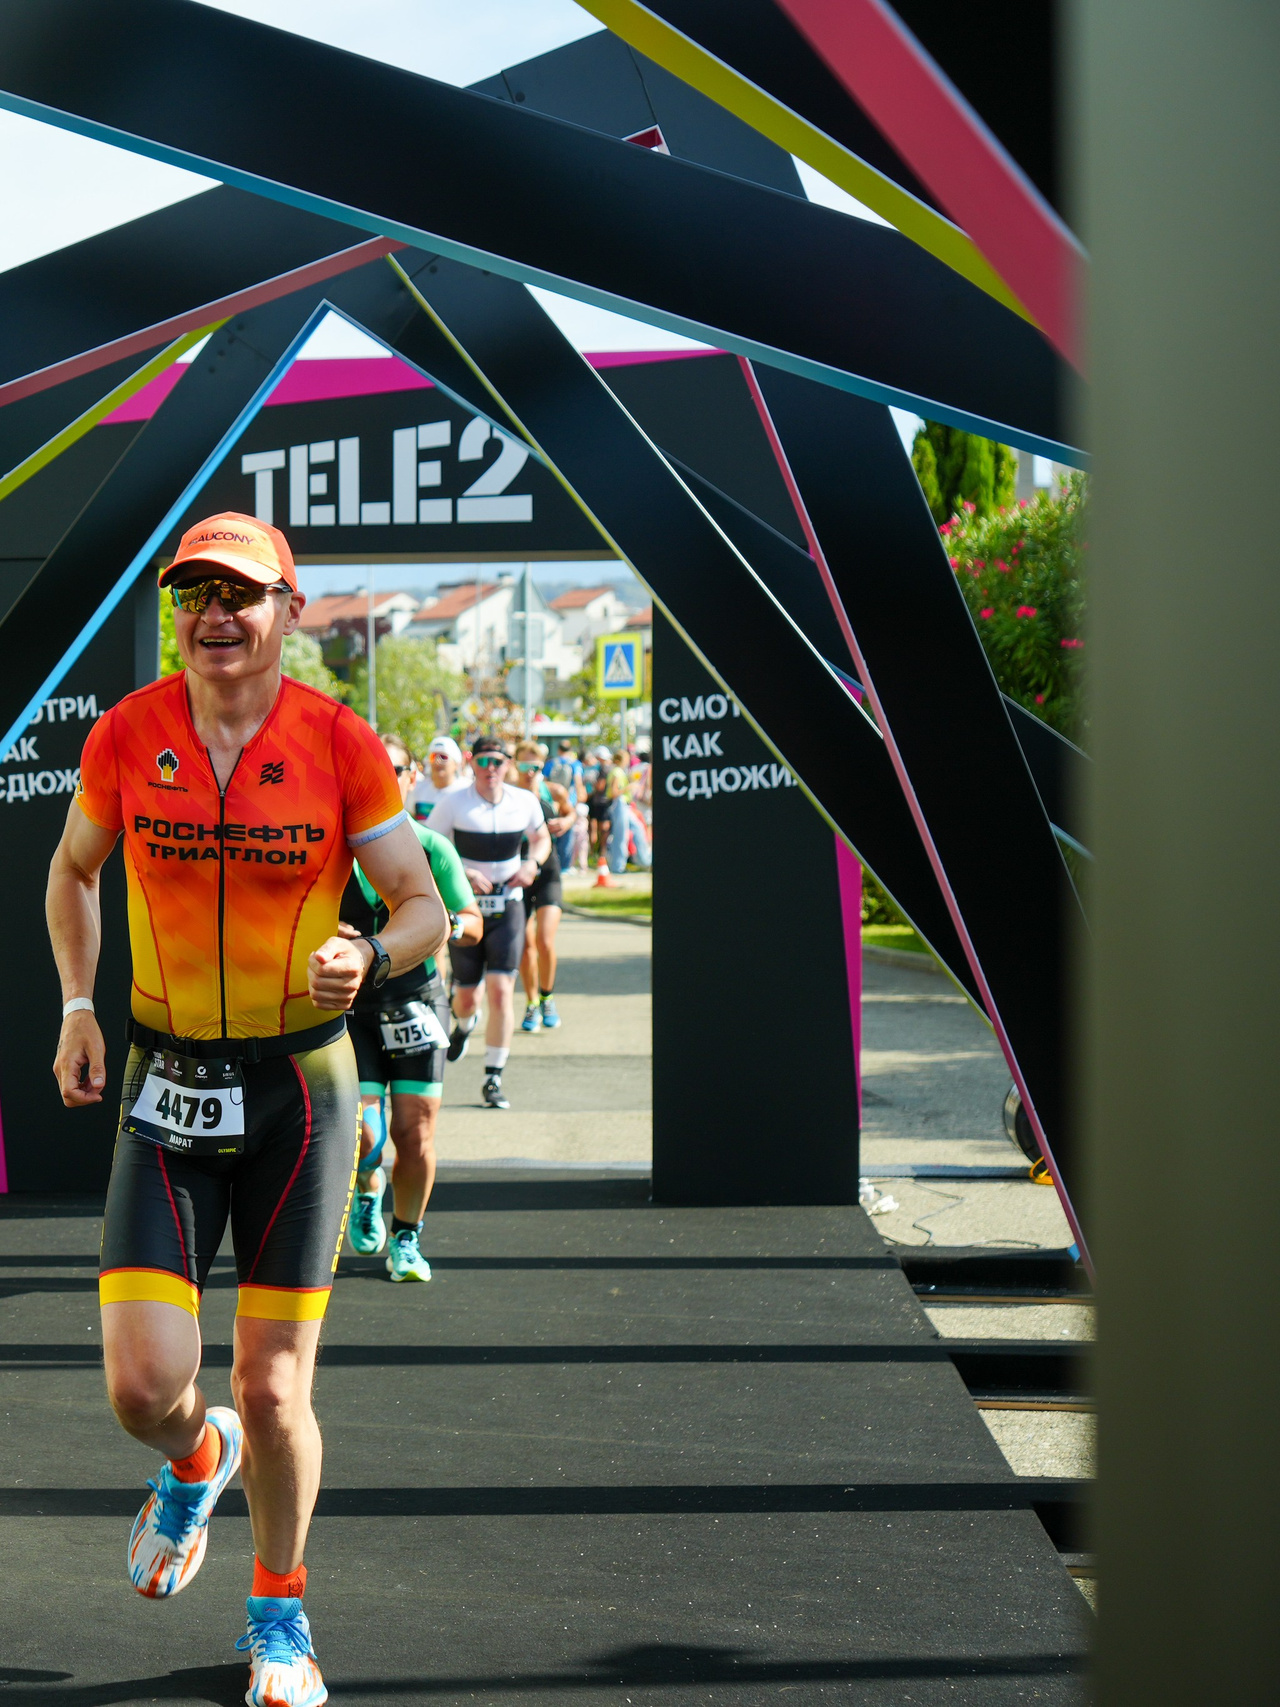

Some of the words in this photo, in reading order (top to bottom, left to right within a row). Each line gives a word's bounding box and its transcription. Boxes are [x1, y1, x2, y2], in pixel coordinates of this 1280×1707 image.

[241, 415, 534, 527] TELE2
[186, 531, 254, 547] SAUCONY
[1, 736, 41, 763] АК
[662, 731, 724, 761] КАК
[147, 781, 189, 793] РОСНЕФТЬ
[134, 815, 325, 844] РОСНЕФТЬ
[145, 842, 308, 866] ТРИАТЛОН
[154, 1087, 224, 1130] 4479
